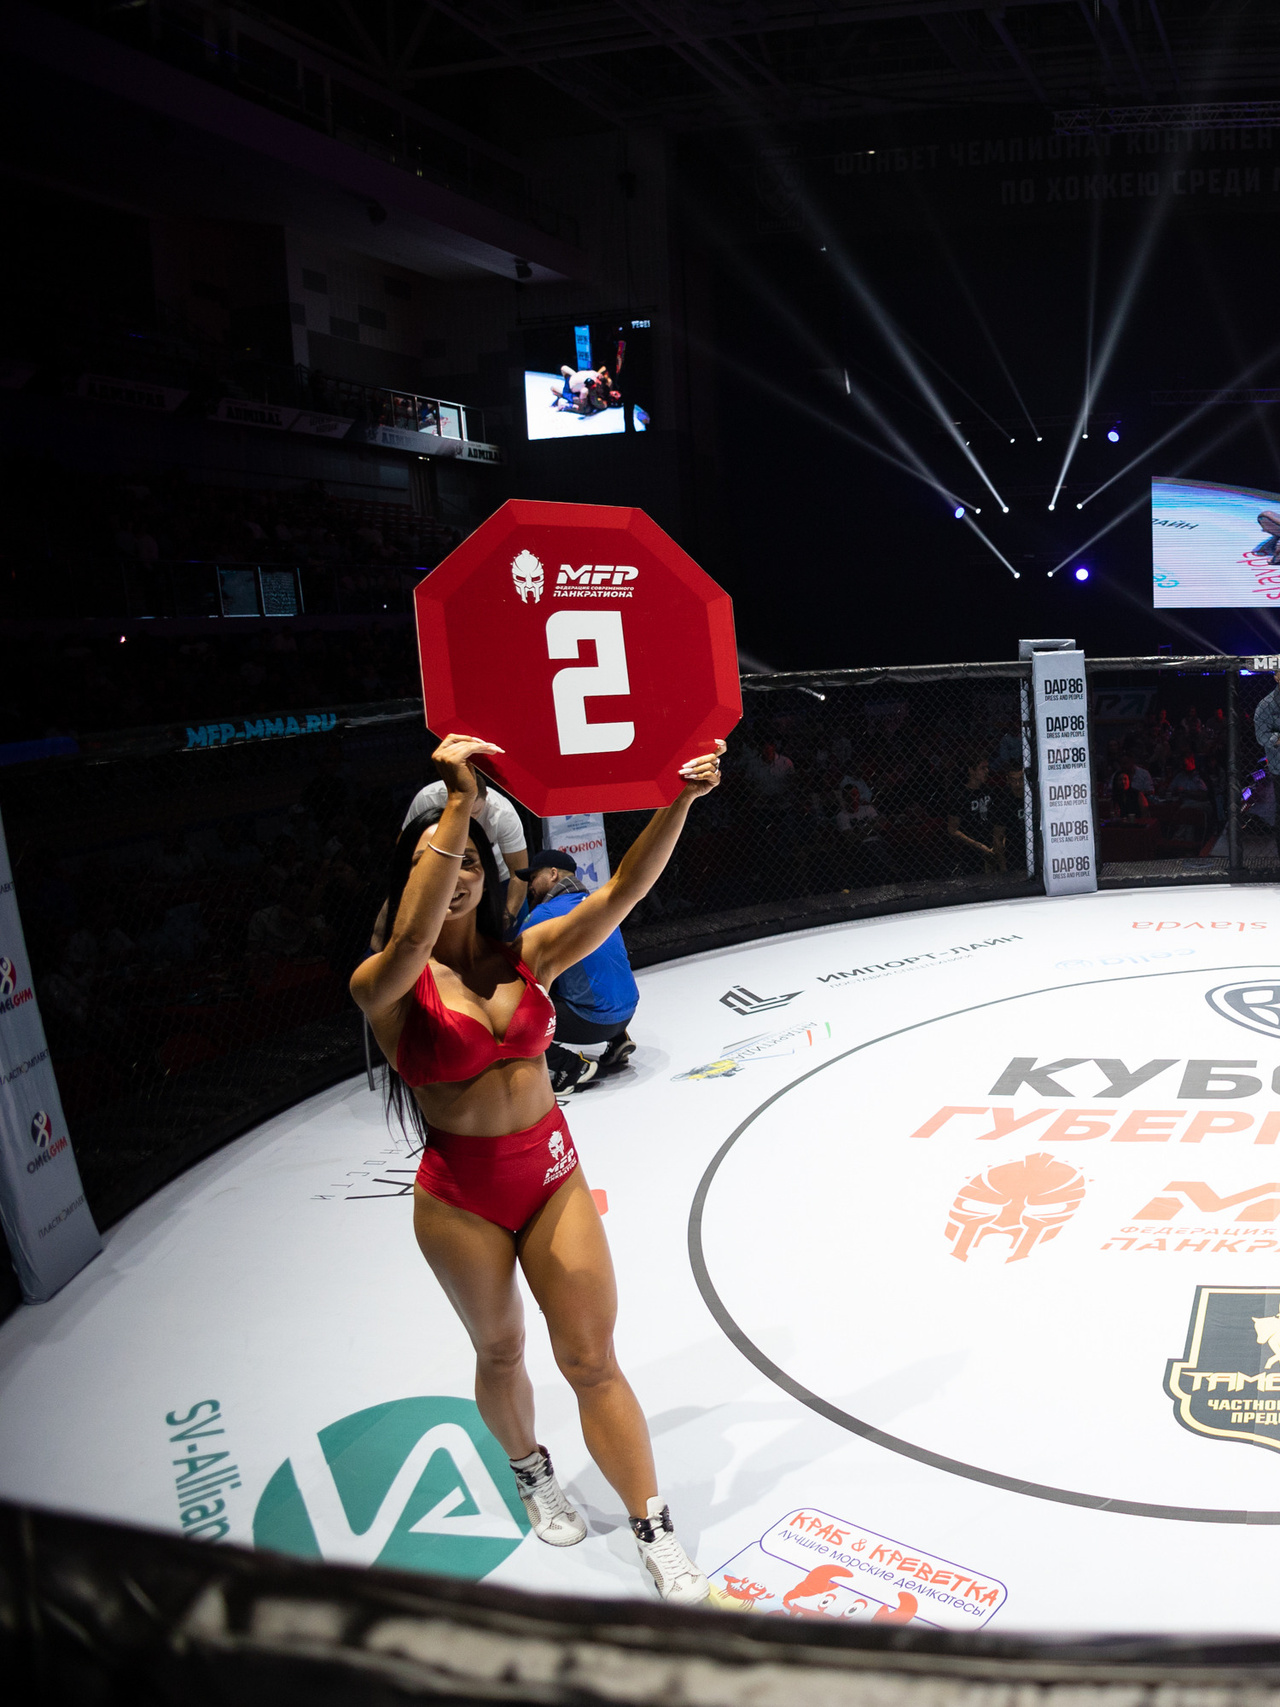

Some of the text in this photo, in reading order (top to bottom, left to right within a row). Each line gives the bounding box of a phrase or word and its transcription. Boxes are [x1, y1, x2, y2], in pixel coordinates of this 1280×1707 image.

[950, 131, 1112, 167] ЧЕМПИОНАТ
[1001, 178, 1036, 205] ПО
[1046, 170, 1159, 203] ХОККЕЮ
[1172, 166, 1259, 199] СРЕДИ
[556, 564, 639, 585] MFP
[553, 590, 633, 598] ПАНКРАТИОНА
[546, 610, 636, 755] 2
[185, 713, 337, 748] MFP-MMA.RU
[1131, 920, 1267, 932] slavda
[816, 934, 1024, 984] ИМПОРТ-ЛАЙН
[545, 1148, 574, 1180] MFP
[1120, 1226, 1279, 1236] ФЕДЕРАЦИЯ
[777, 1528, 987, 1618] лучшие морские деликатесы
[789, 1512, 1000, 1608] КРАБ & КРЕВЕТКА
